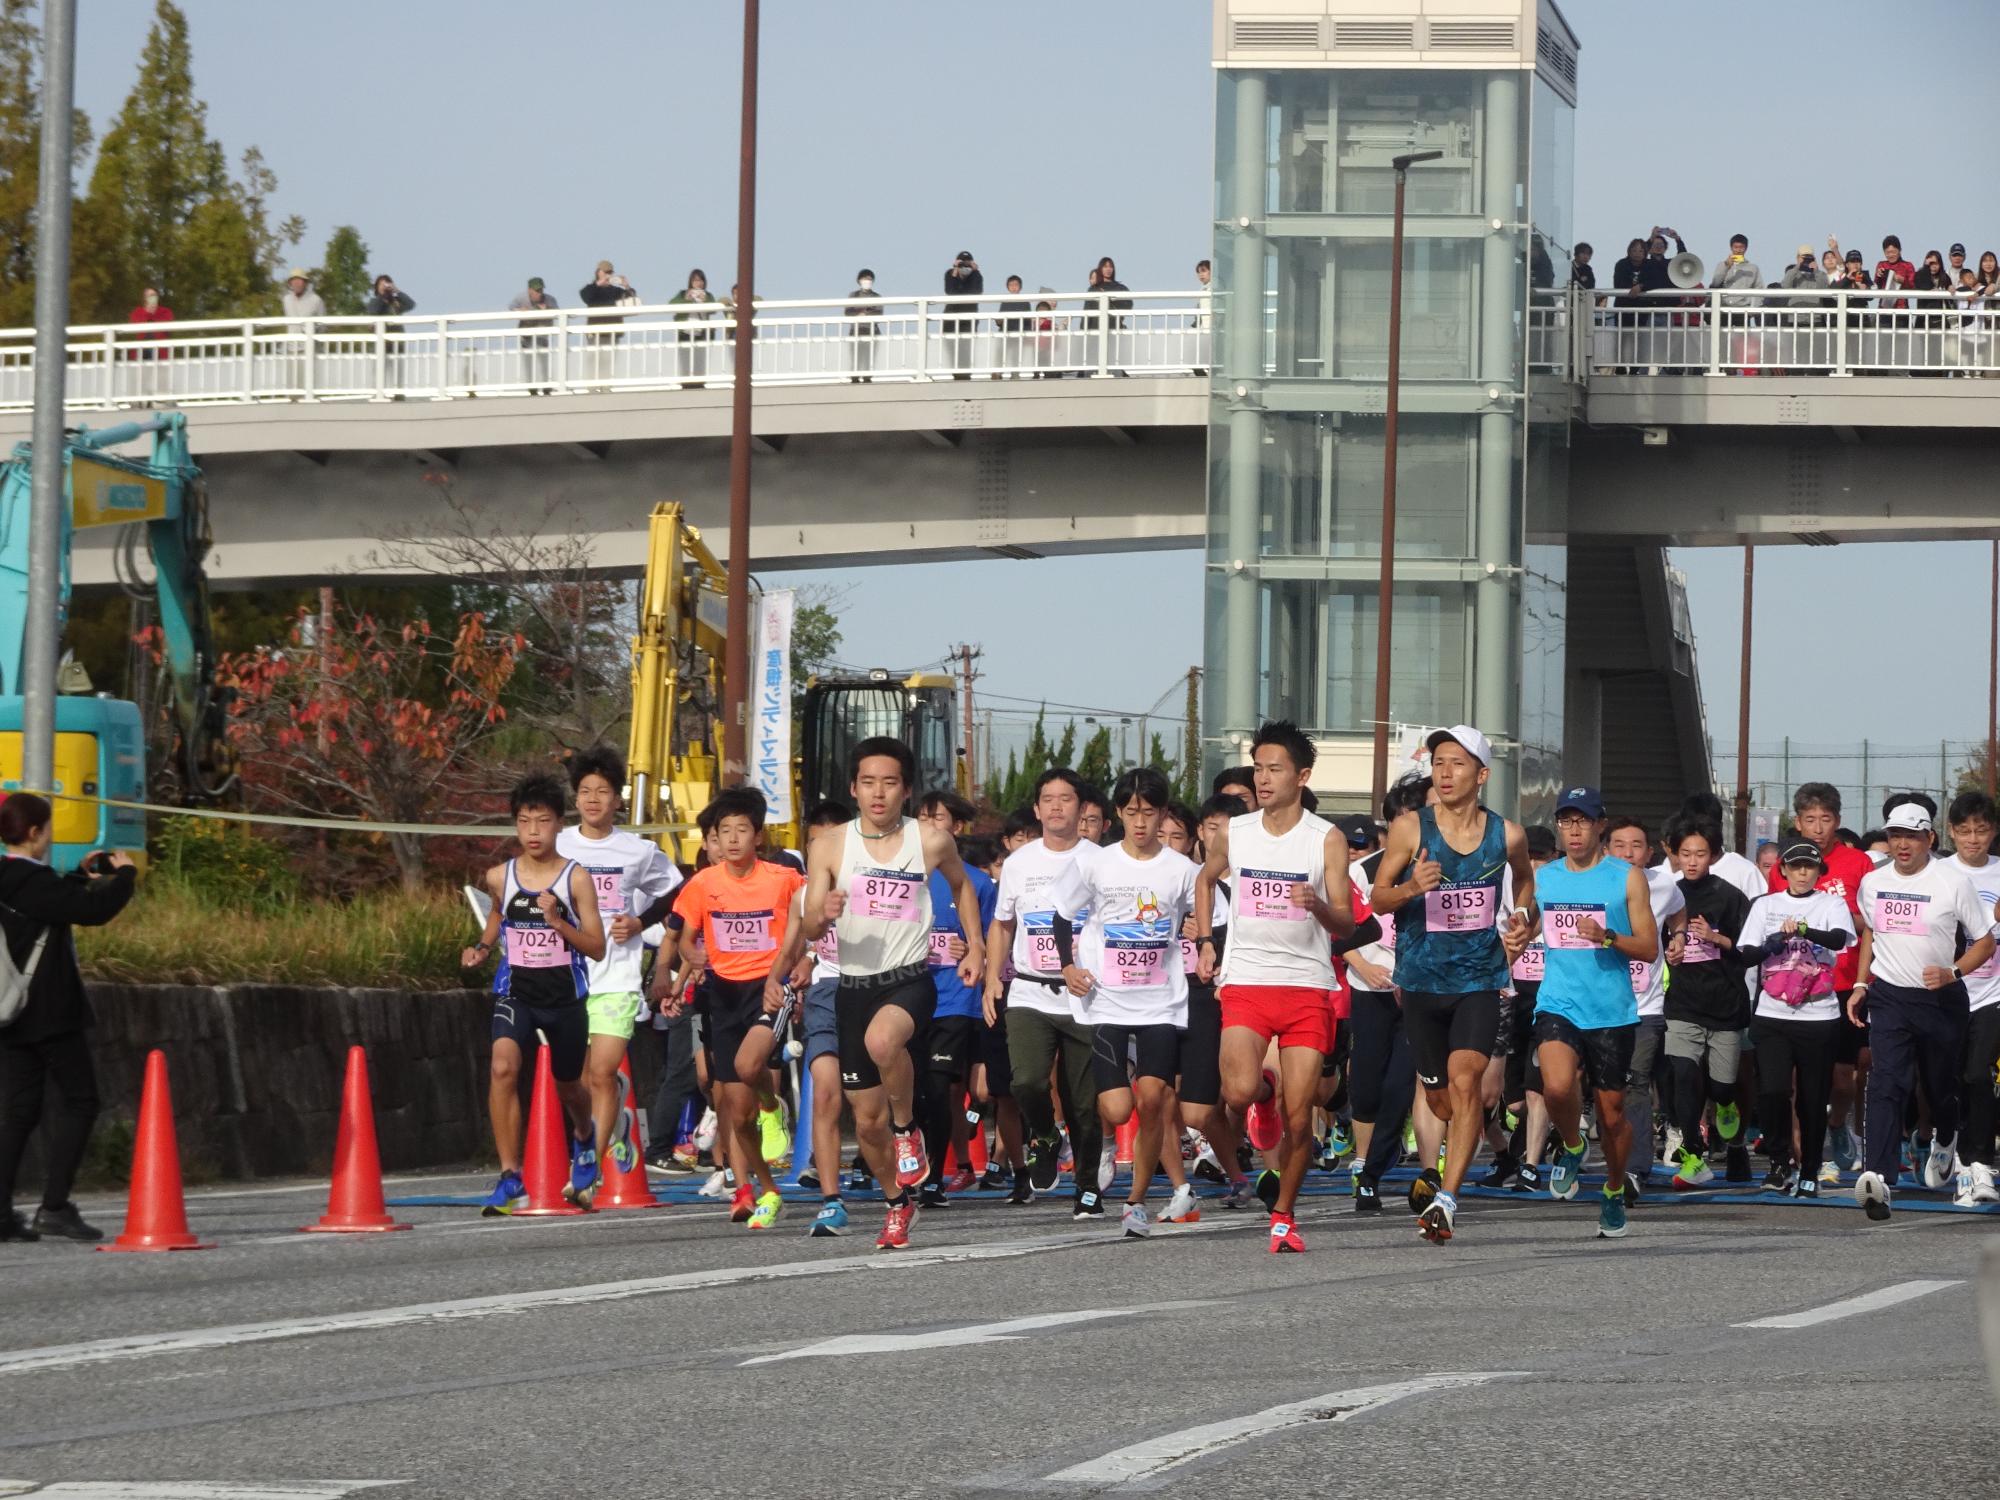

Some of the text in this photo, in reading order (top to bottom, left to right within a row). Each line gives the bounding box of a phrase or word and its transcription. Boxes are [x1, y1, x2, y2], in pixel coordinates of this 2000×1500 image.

[866, 879, 910, 899] 8172
[1252, 881, 1293, 899] 8193
[1441, 891, 1485, 909] 8153
[1884, 901, 1919, 916] 8081
[724, 920, 763, 934] 7021
[516, 931, 558, 947] 7024
[1117, 951, 1158, 967] 8249
